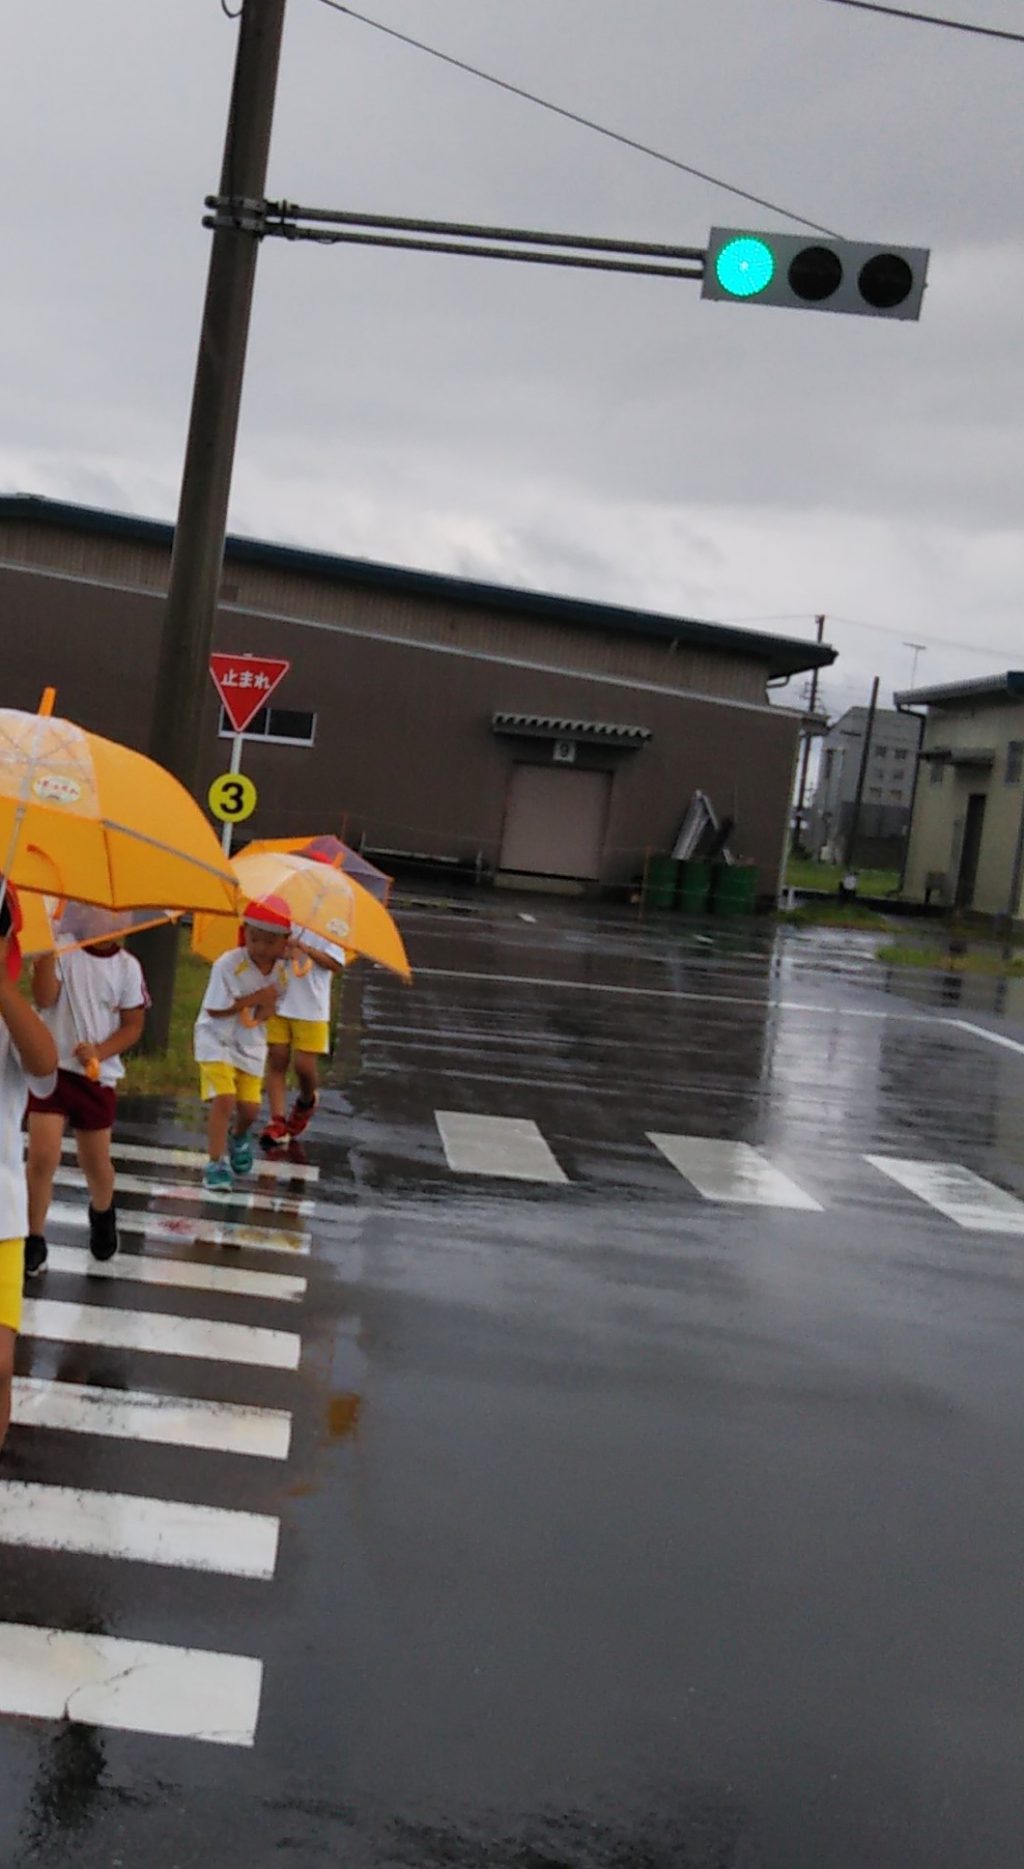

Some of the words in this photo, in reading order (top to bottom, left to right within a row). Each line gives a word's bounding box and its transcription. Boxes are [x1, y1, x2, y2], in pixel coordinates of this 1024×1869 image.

[220, 668, 271, 690] 止まれ
[220, 782, 244, 815] 3
